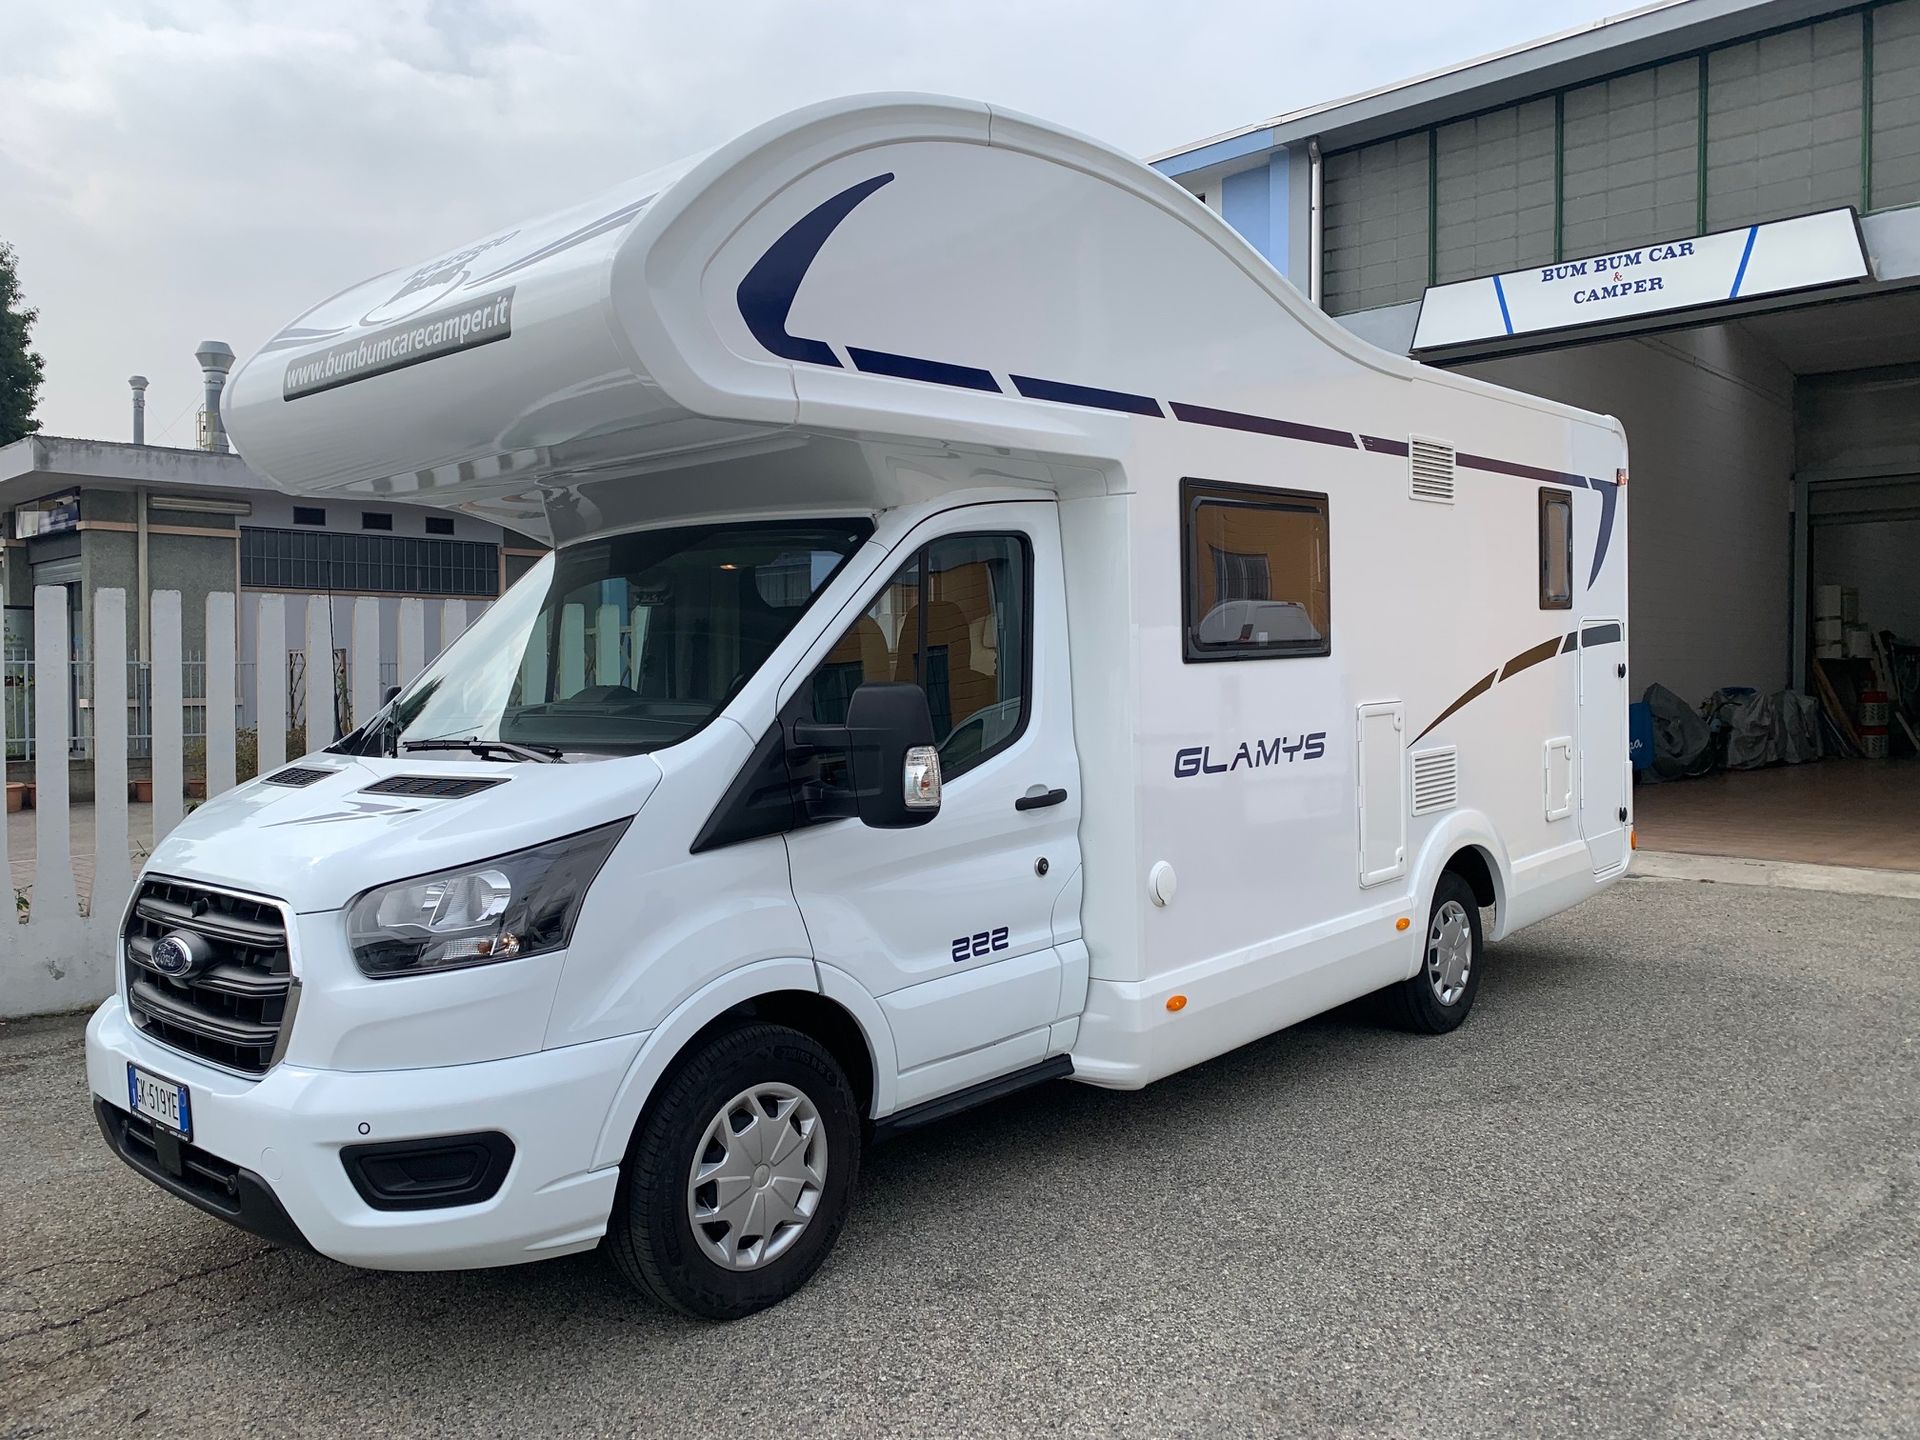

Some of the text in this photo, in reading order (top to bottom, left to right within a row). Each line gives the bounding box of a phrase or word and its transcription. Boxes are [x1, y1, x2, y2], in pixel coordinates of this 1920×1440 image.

[1541, 241, 1695, 283] BUM BUM CAR
[1612, 271, 1623, 283] &
[1573, 277, 1664, 304] CAMPER
[286, 295, 509, 390] www.bumbumcarecamper.it
[1173, 732, 1327, 778] GLAMYS
[155, 941, 178, 968] Ford
[951, 926, 1009, 963] 222
